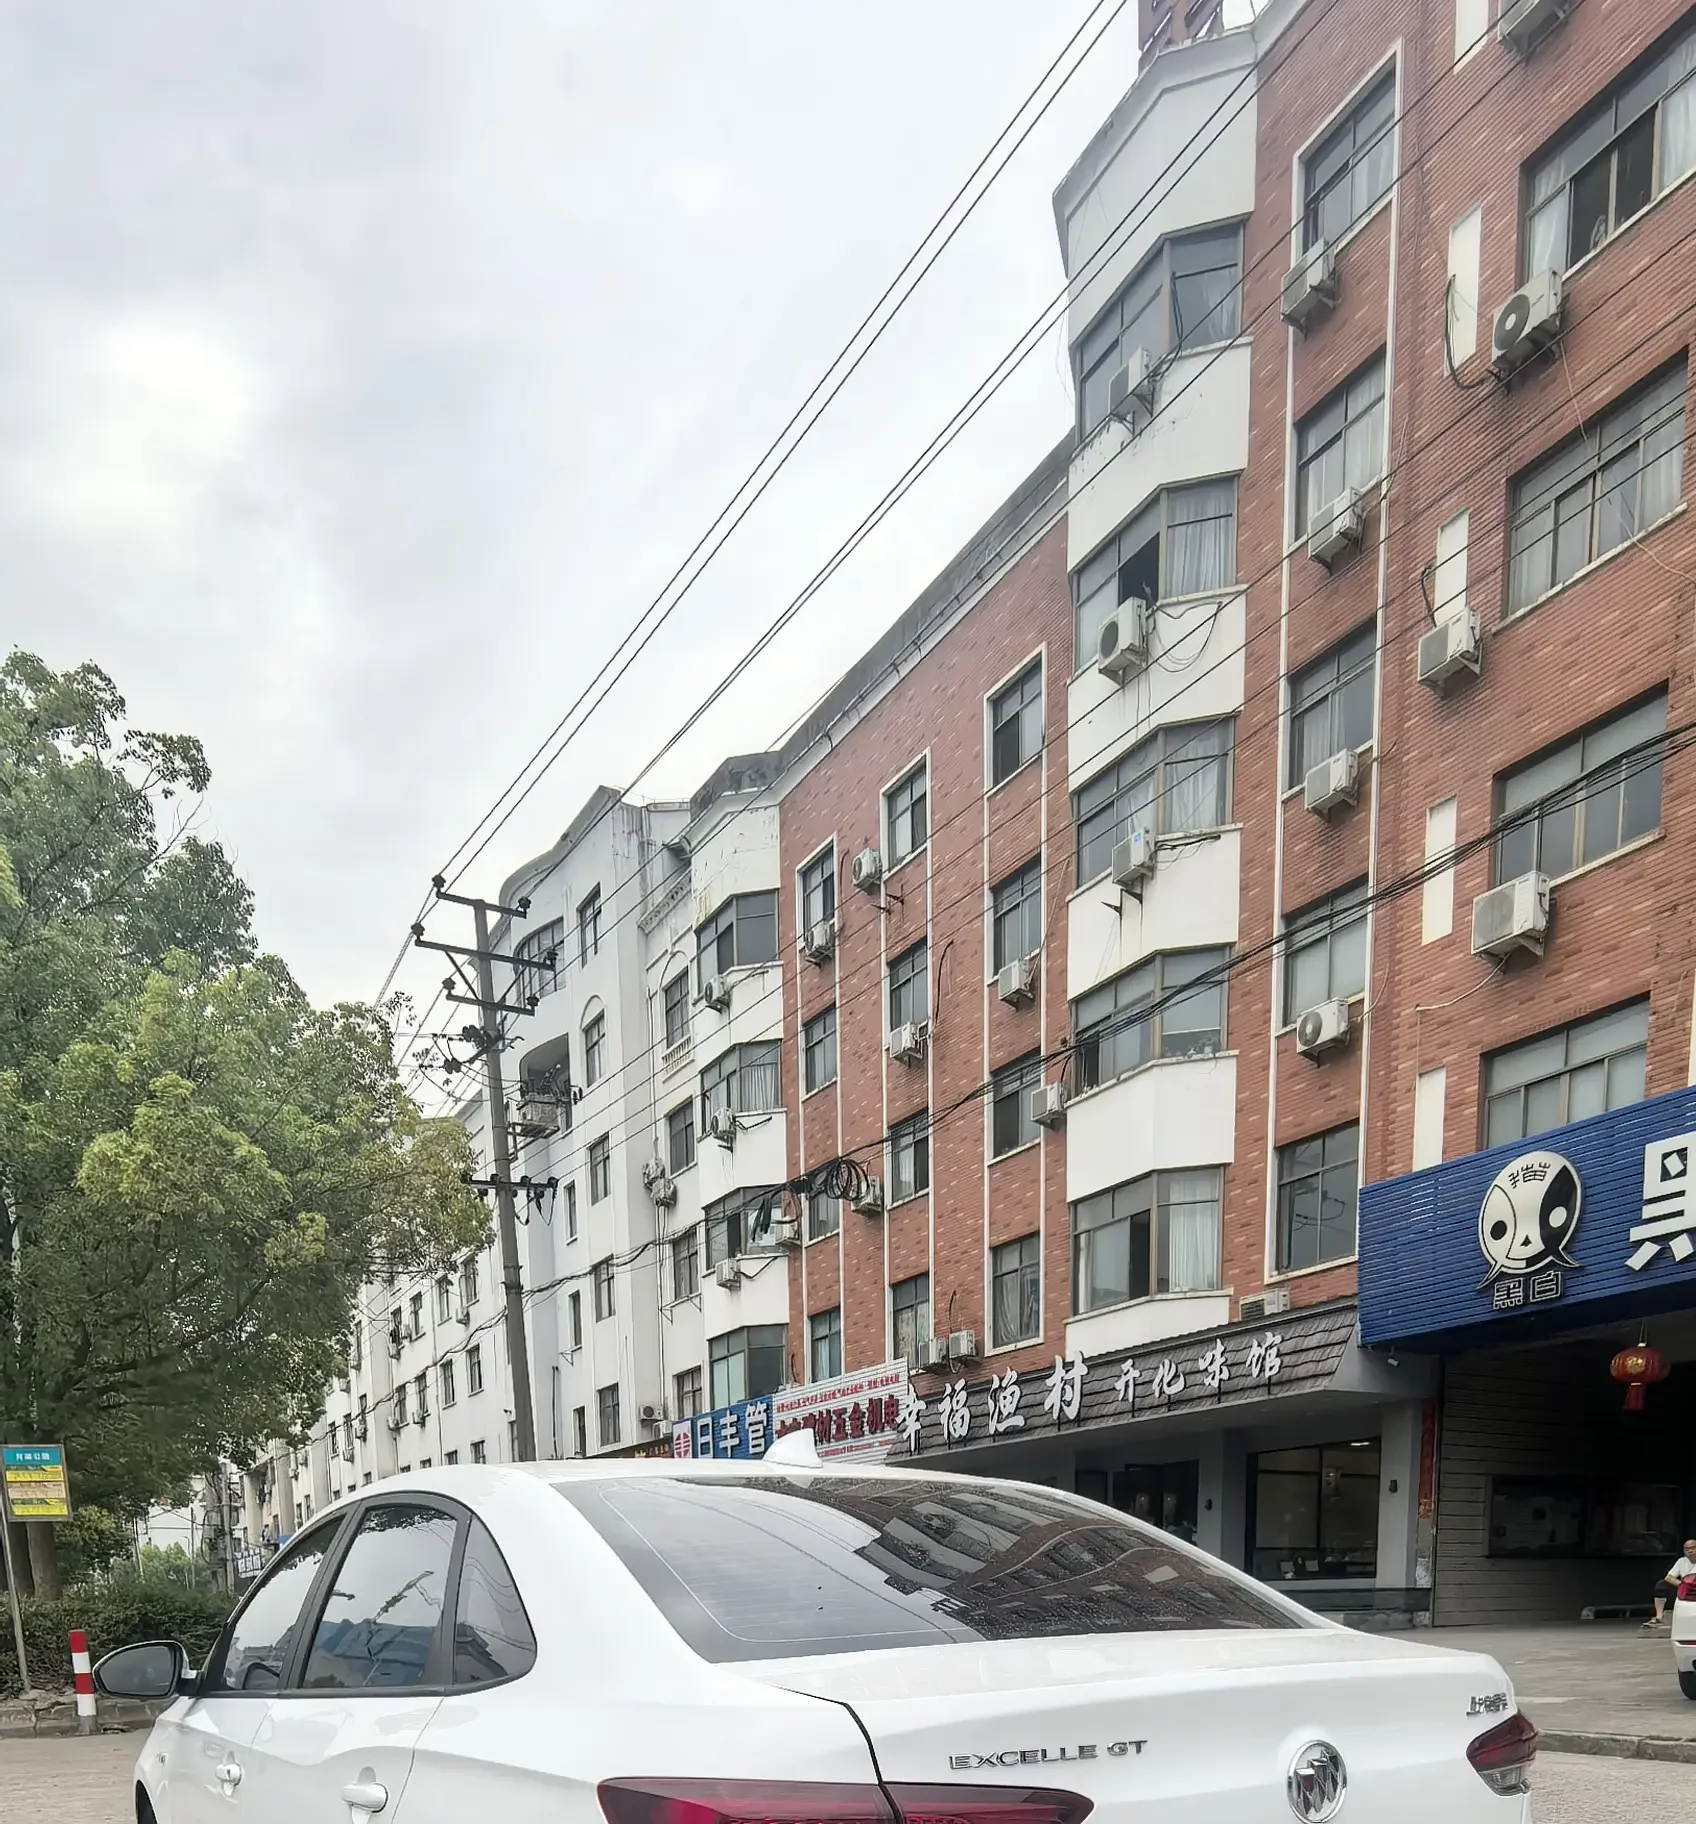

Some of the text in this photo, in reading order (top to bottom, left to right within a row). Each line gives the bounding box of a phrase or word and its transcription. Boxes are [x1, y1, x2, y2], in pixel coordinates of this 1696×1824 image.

[1493, 1270, 1562, 1309] 黑白
[895, 1351, 1089, 1451] 幸福渔村
[1114, 1332, 1283, 1403] 开化味馆
[696, 1401, 769, 1459] 日丰管
[949, 1740, 1149, 1770] EXCELLE GT
